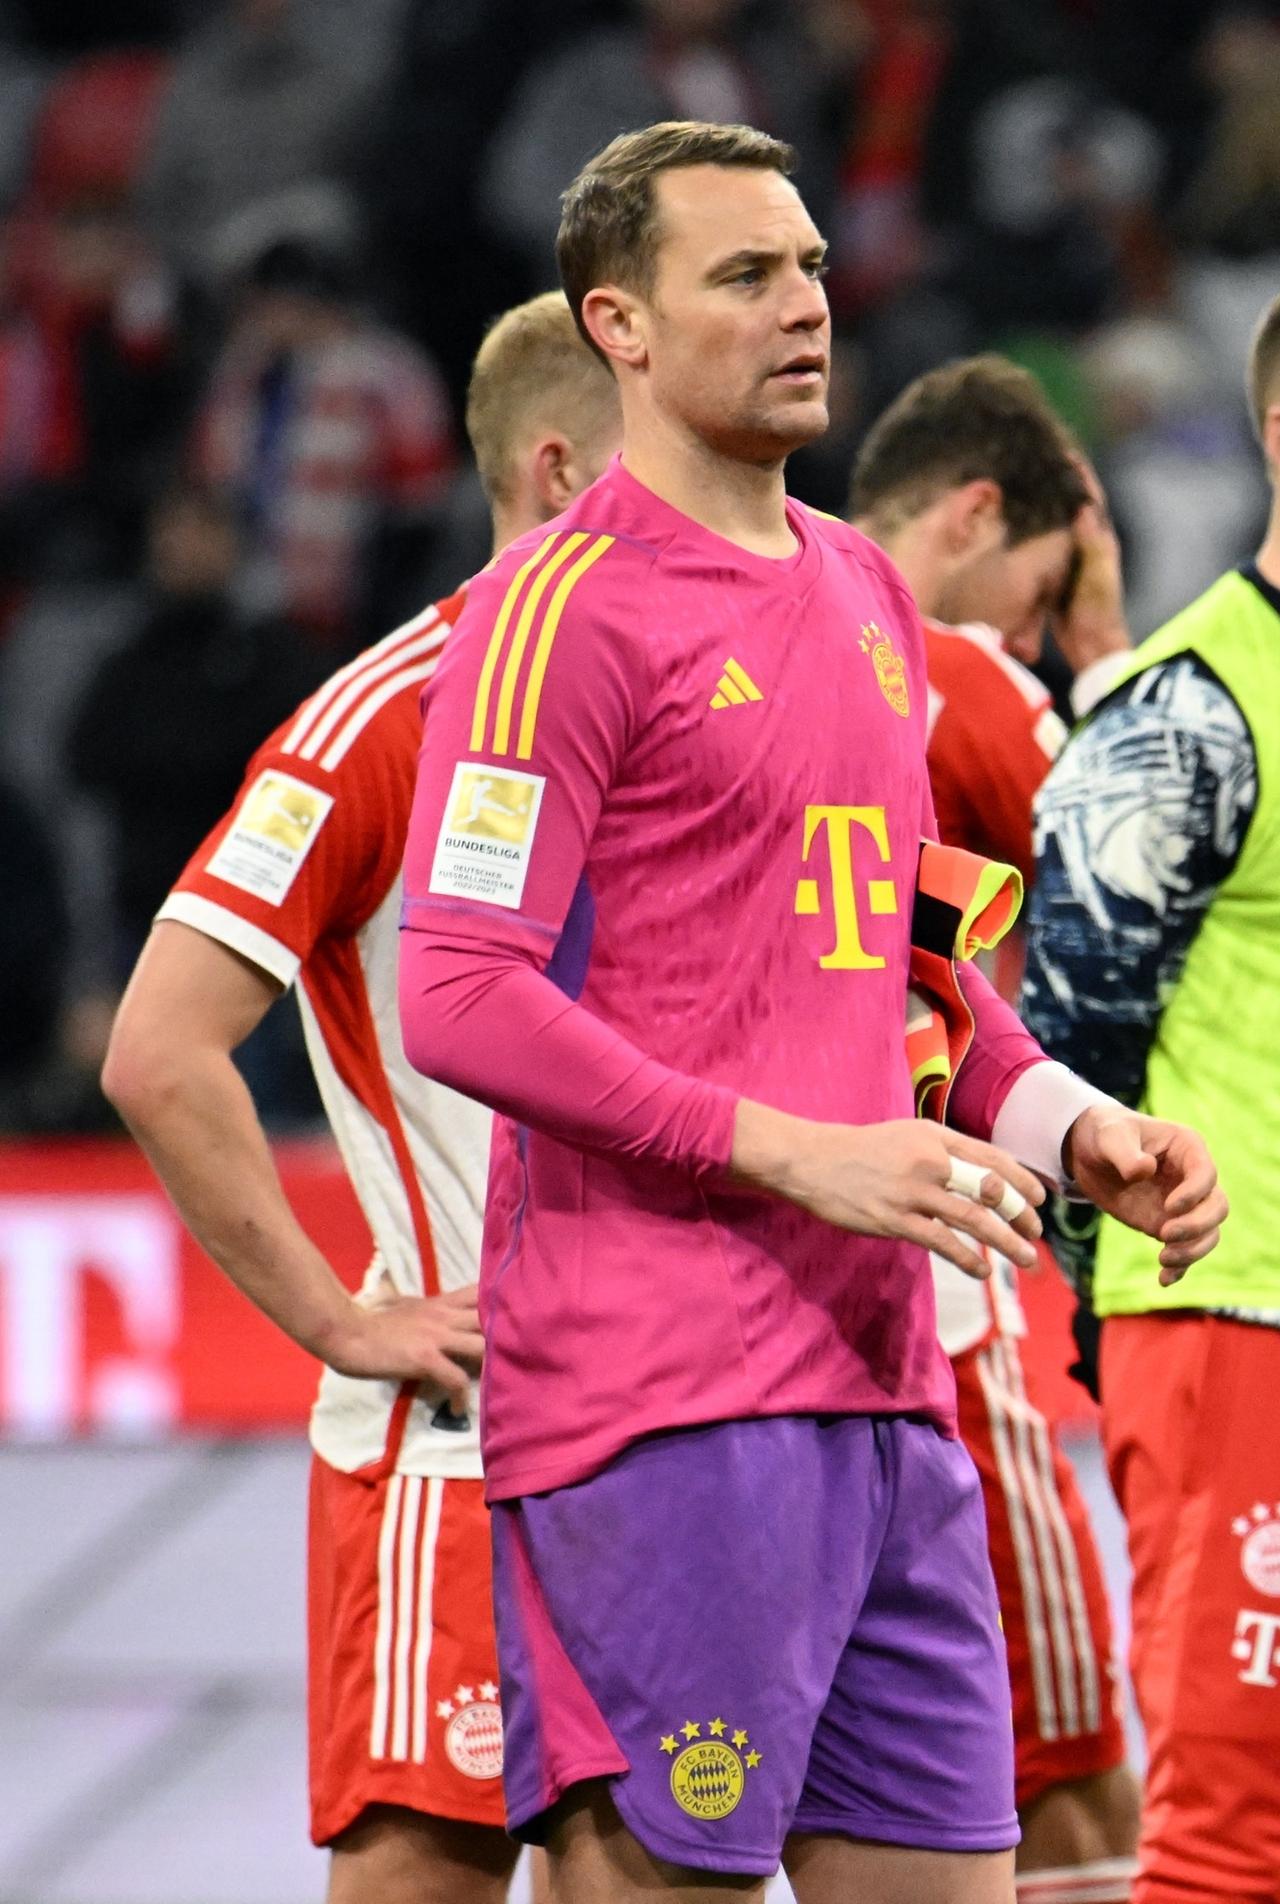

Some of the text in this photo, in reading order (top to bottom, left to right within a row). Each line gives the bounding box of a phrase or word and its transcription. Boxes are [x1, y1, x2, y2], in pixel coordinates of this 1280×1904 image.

[444, 838, 520, 860] BUNDESLIGA
[795, 805, 898, 969] T
[680, 1748, 739, 1779] FC BAYERN
